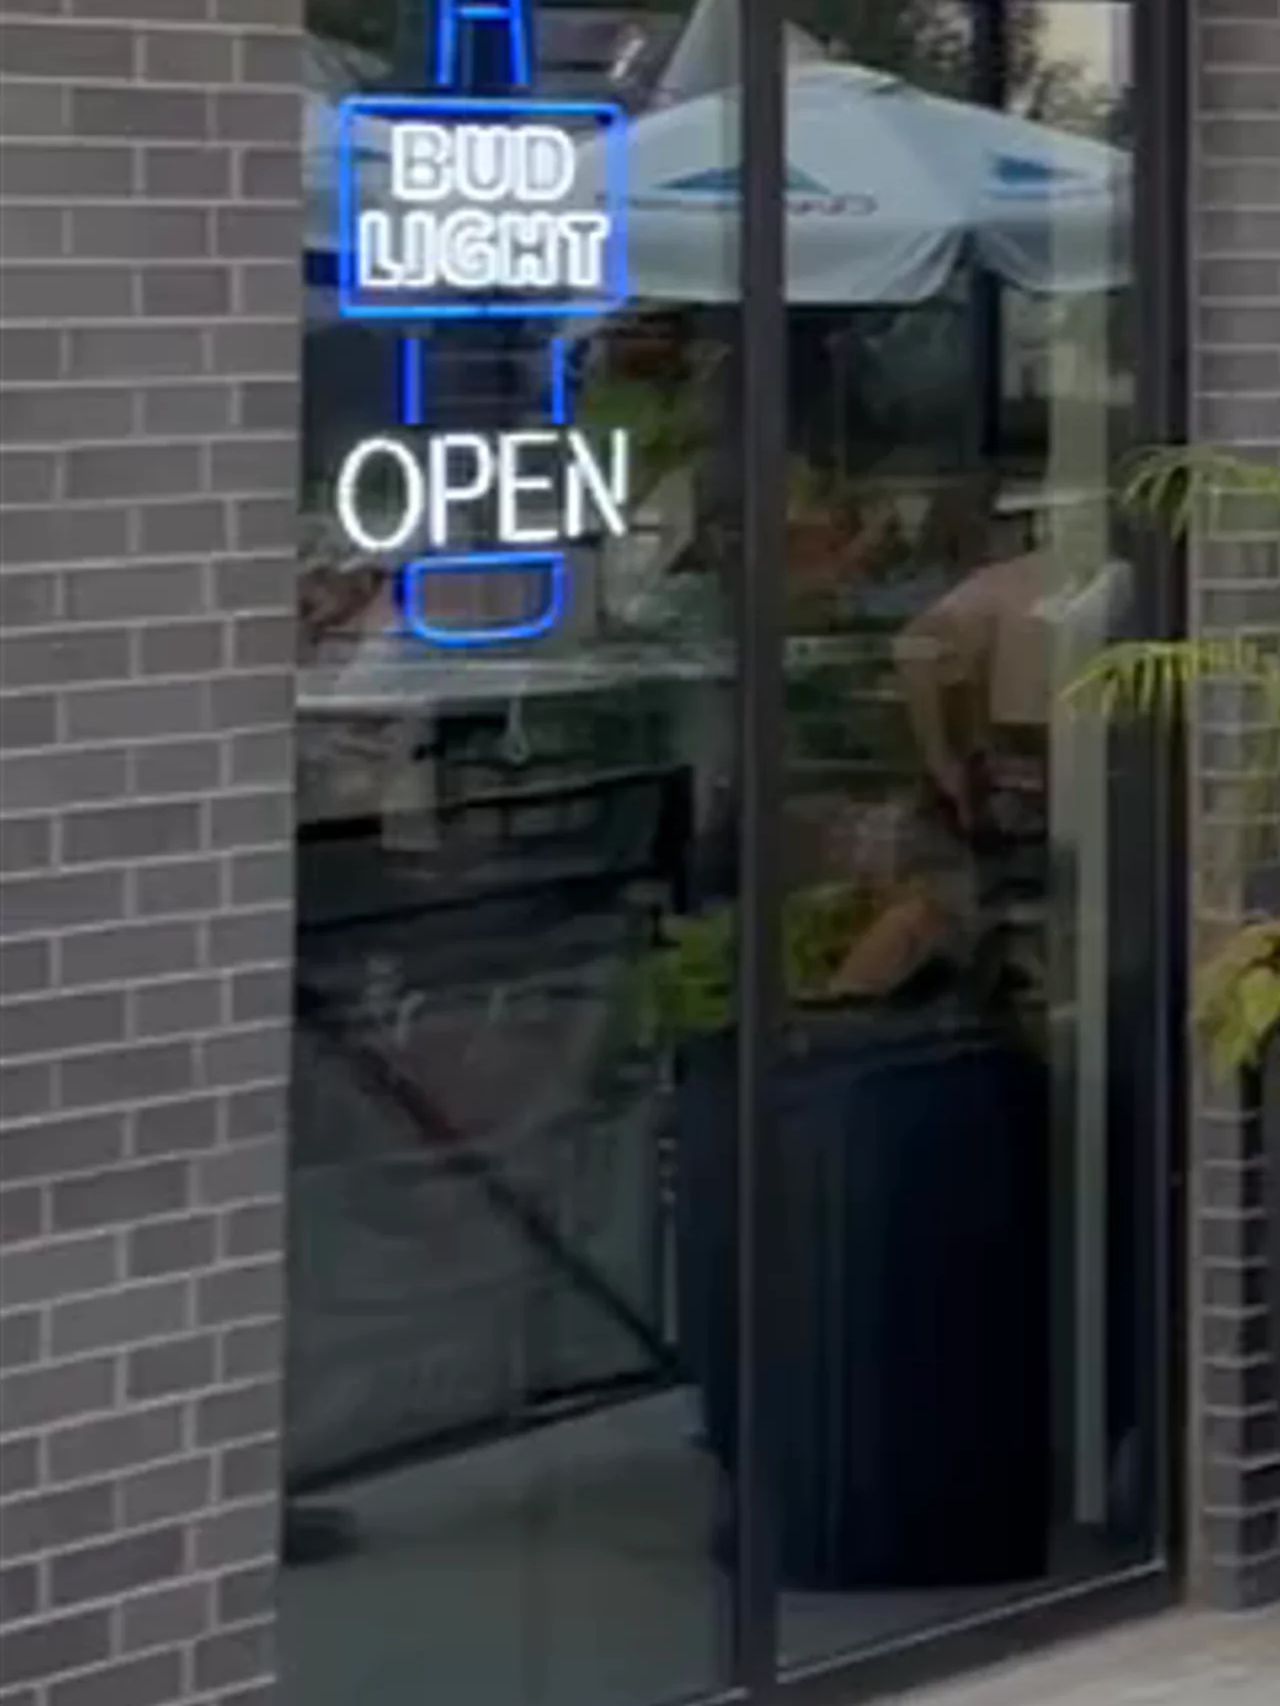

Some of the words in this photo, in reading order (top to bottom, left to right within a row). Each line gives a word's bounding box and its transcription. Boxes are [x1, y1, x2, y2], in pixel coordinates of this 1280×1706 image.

[391, 122, 577, 202] BUD
[357, 210, 611, 289] LIGHT
[336, 429, 630, 550] OPEN
